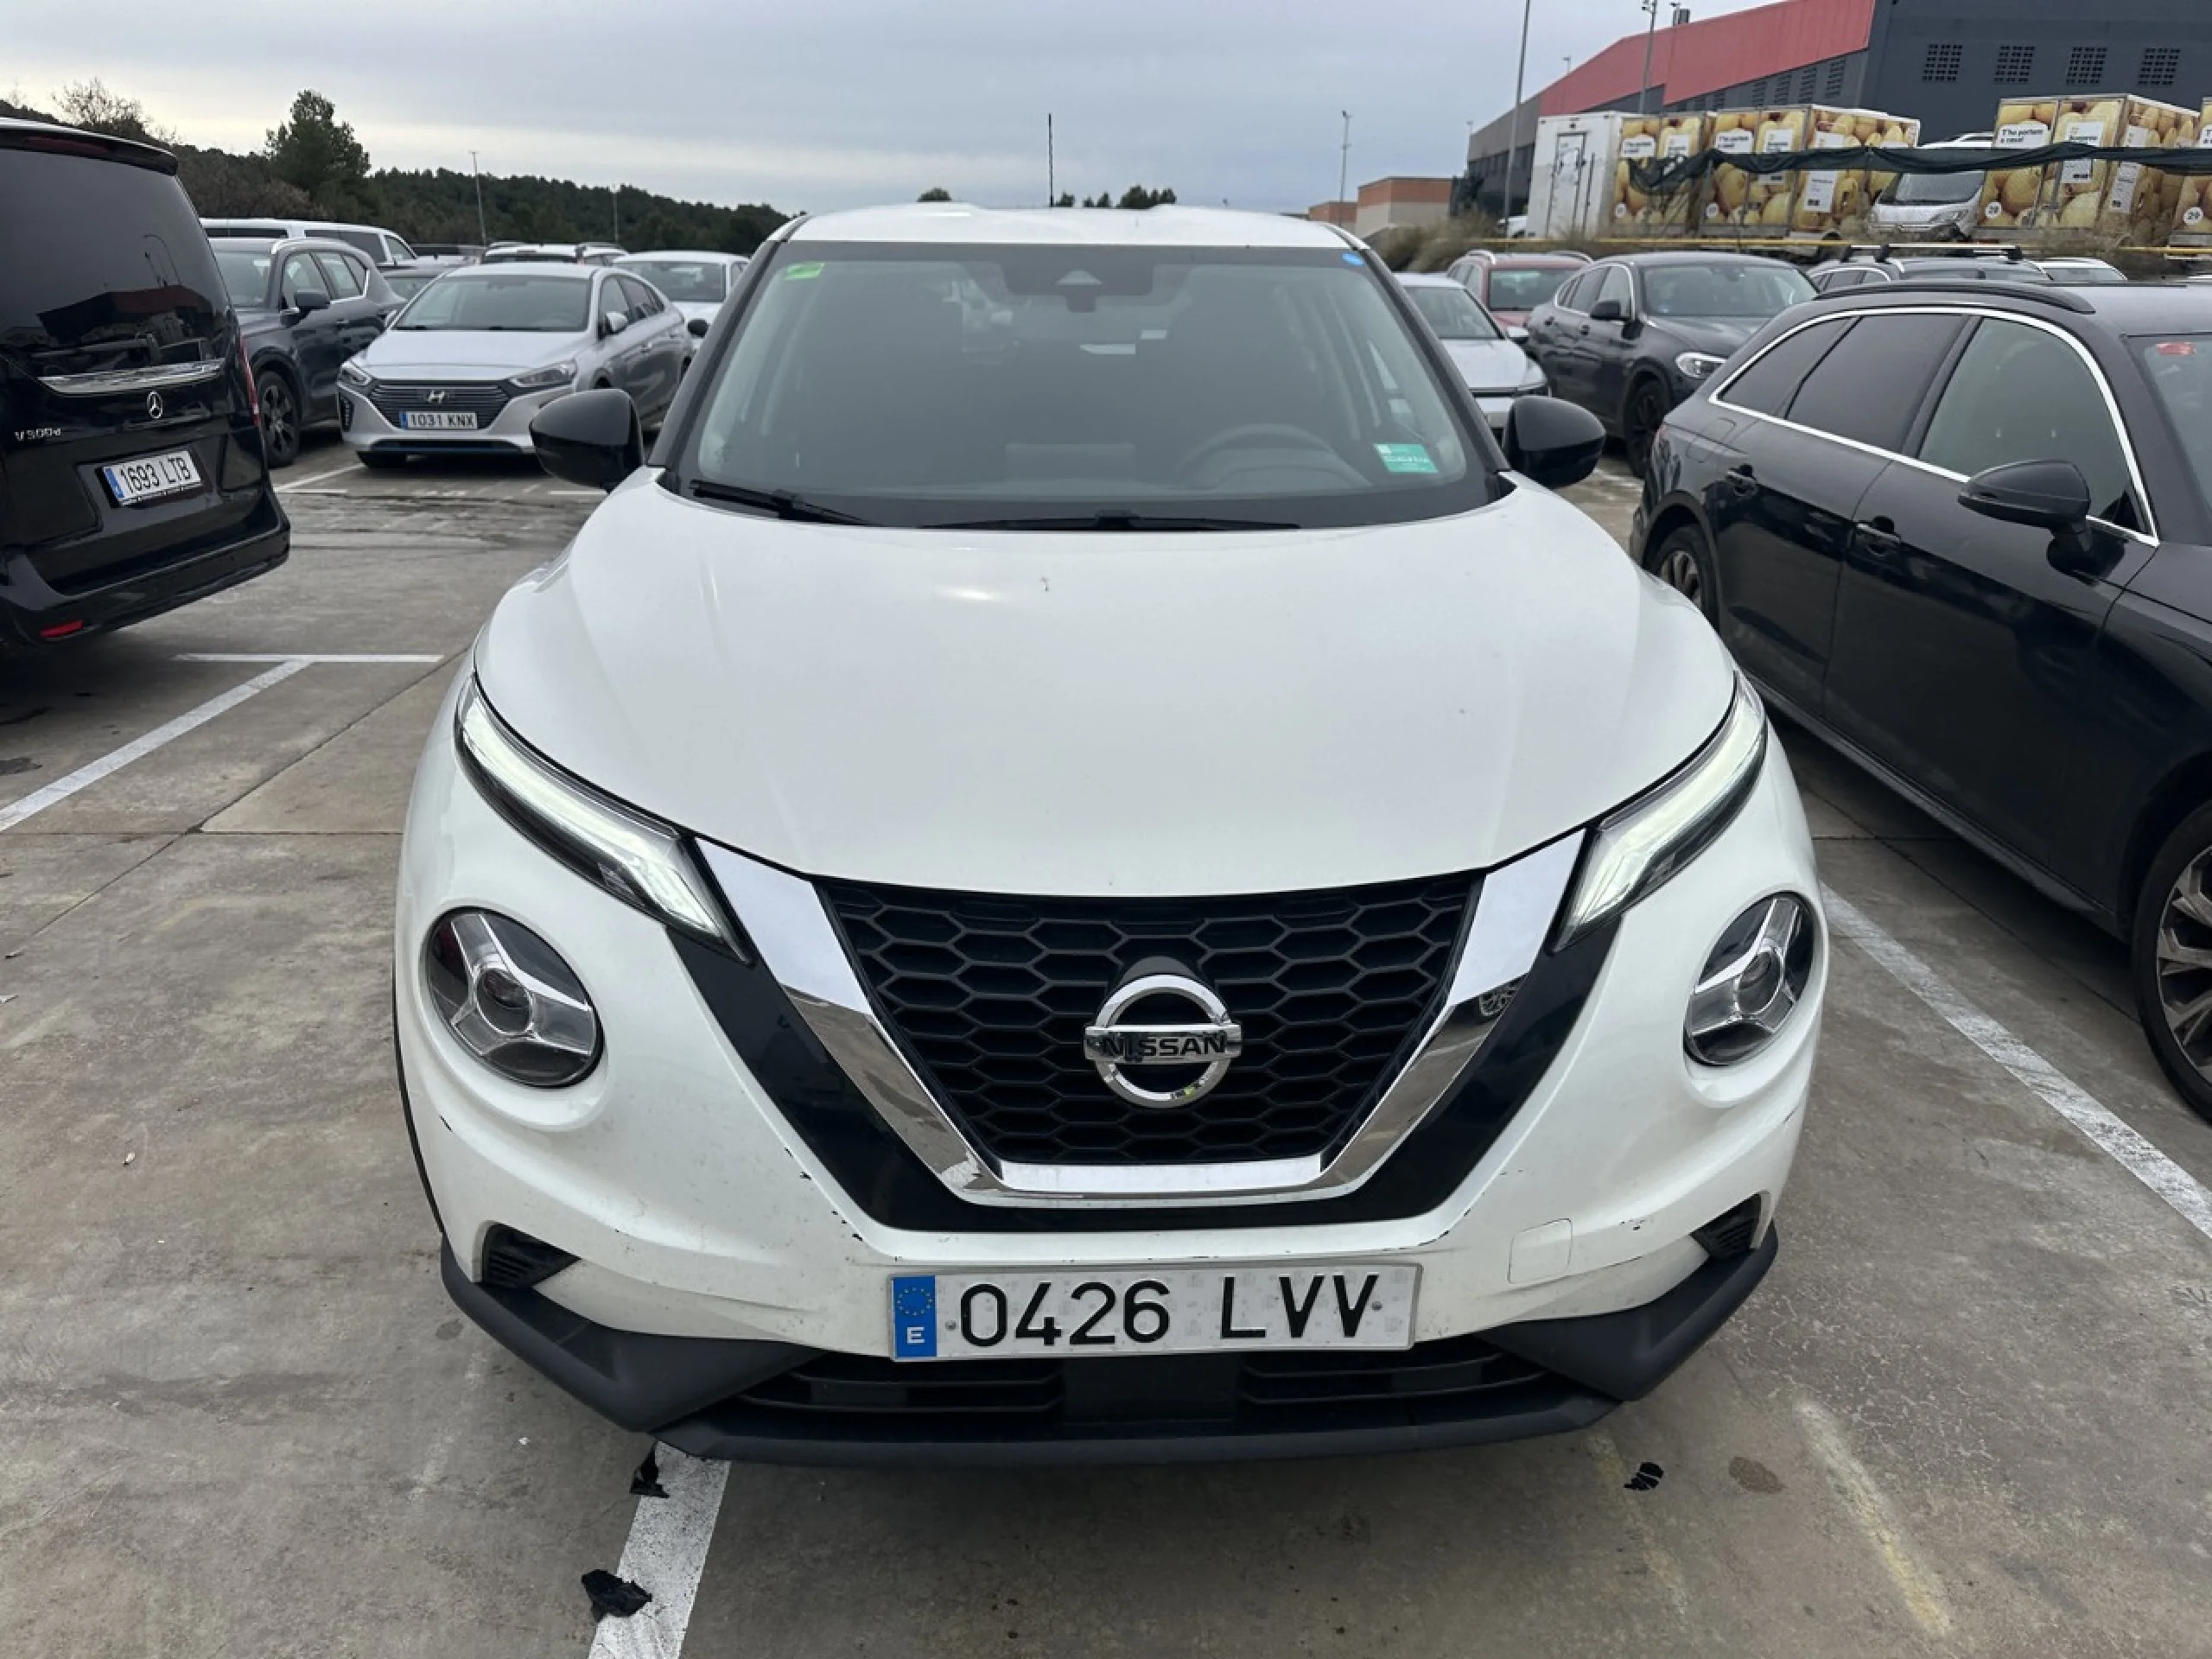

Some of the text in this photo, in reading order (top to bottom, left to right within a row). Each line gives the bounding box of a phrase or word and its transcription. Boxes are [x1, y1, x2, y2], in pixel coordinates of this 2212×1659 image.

[410, 414, 474, 427] 1031 KNX
[120, 457, 191, 493] 1693 LTB
[1103, 1032, 1226, 1056] NISSAN
[959, 1274, 1379, 1347] 0426 LVV
[906, 1325, 925, 1344] E
